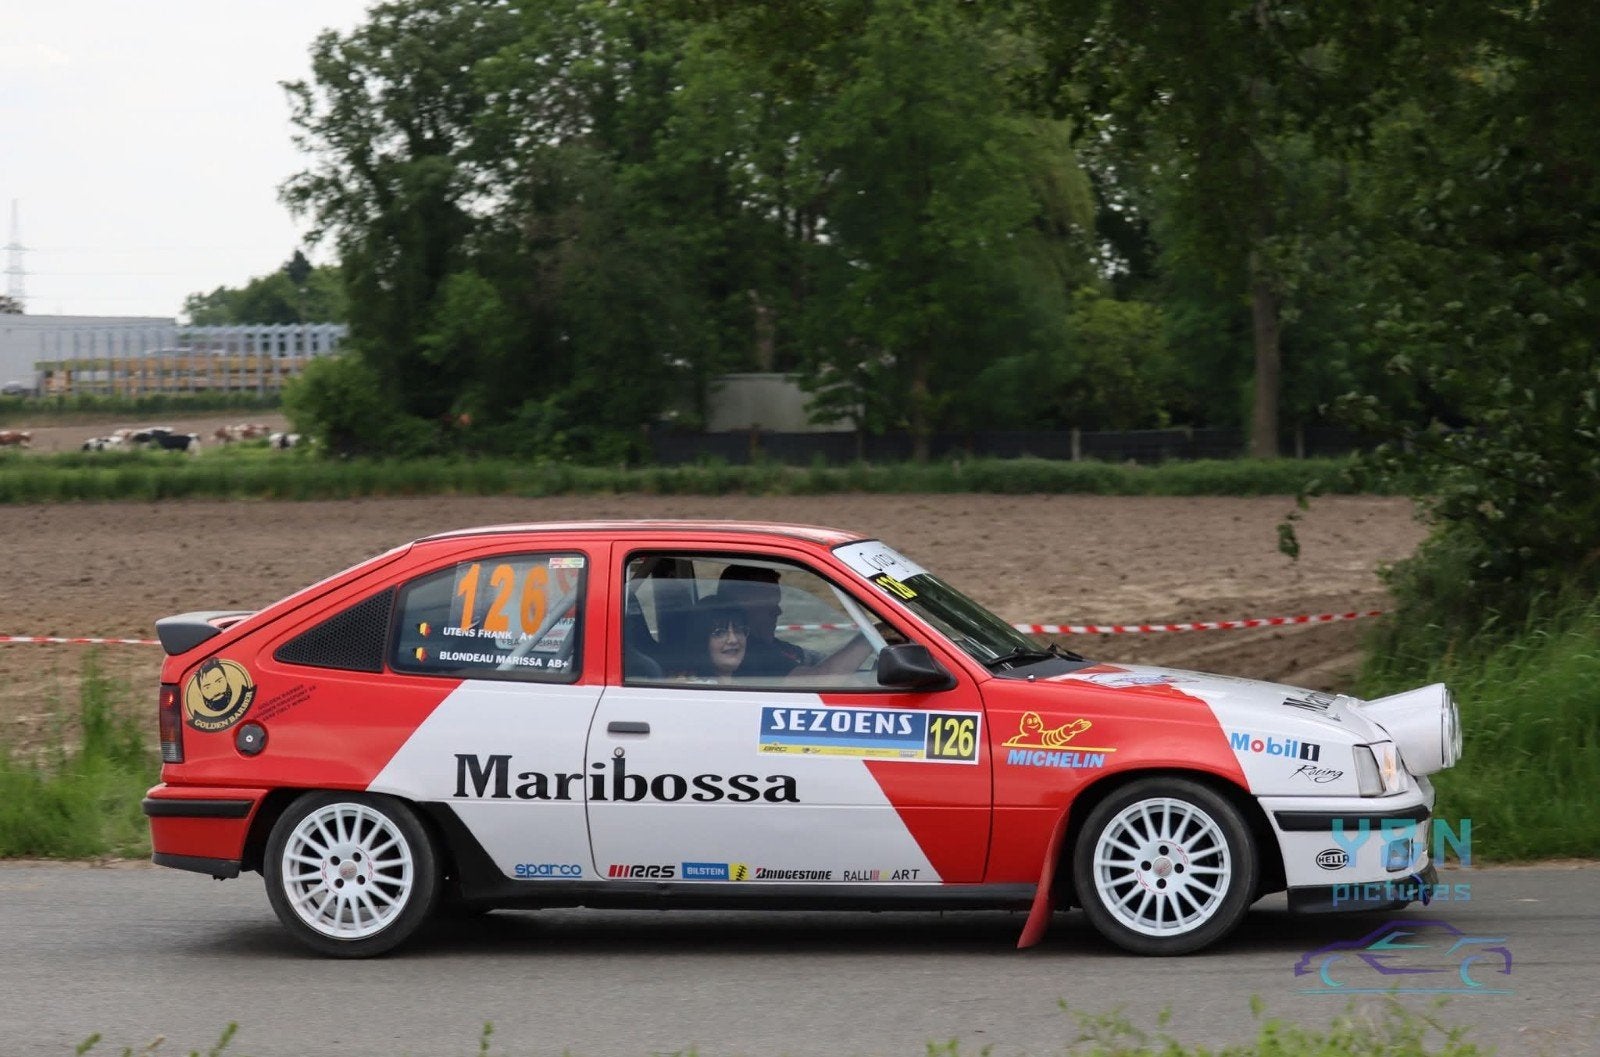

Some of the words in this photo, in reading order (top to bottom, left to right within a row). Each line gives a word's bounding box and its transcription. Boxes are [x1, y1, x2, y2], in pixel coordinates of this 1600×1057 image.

[457, 563, 549, 636] 126
[443, 627, 476, 638] UTENS
[477, 629, 512, 640] FRANK
[439, 651, 494, 664] BLONDEAU
[494, 655, 543, 667] MARISSA
[547, 659, 569, 668] AB+
[194, 719, 230, 730] GOLDEN
[230, 691, 253, 724] BARBER
[771, 709, 913, 735] SEZOENS
[930, 717, 974, 757] 126
[1230, 732, 1298, 758] Mobil
[1007, 749, 1105, 768] MICHELIN
[452, 754, 801, 802] Maribossa
[1289, 764, 1344, 783] Racing
[1318, 854, 1350, 864] HELLA
[514, 864, 582, 878] sparco
[630, 865, 676, 878] RRS
[686, 867, 725, 877] BILSTEIN
[756, 867, 832, 880] BRIDGESTONE
[892, 869, 920, 880] ART
